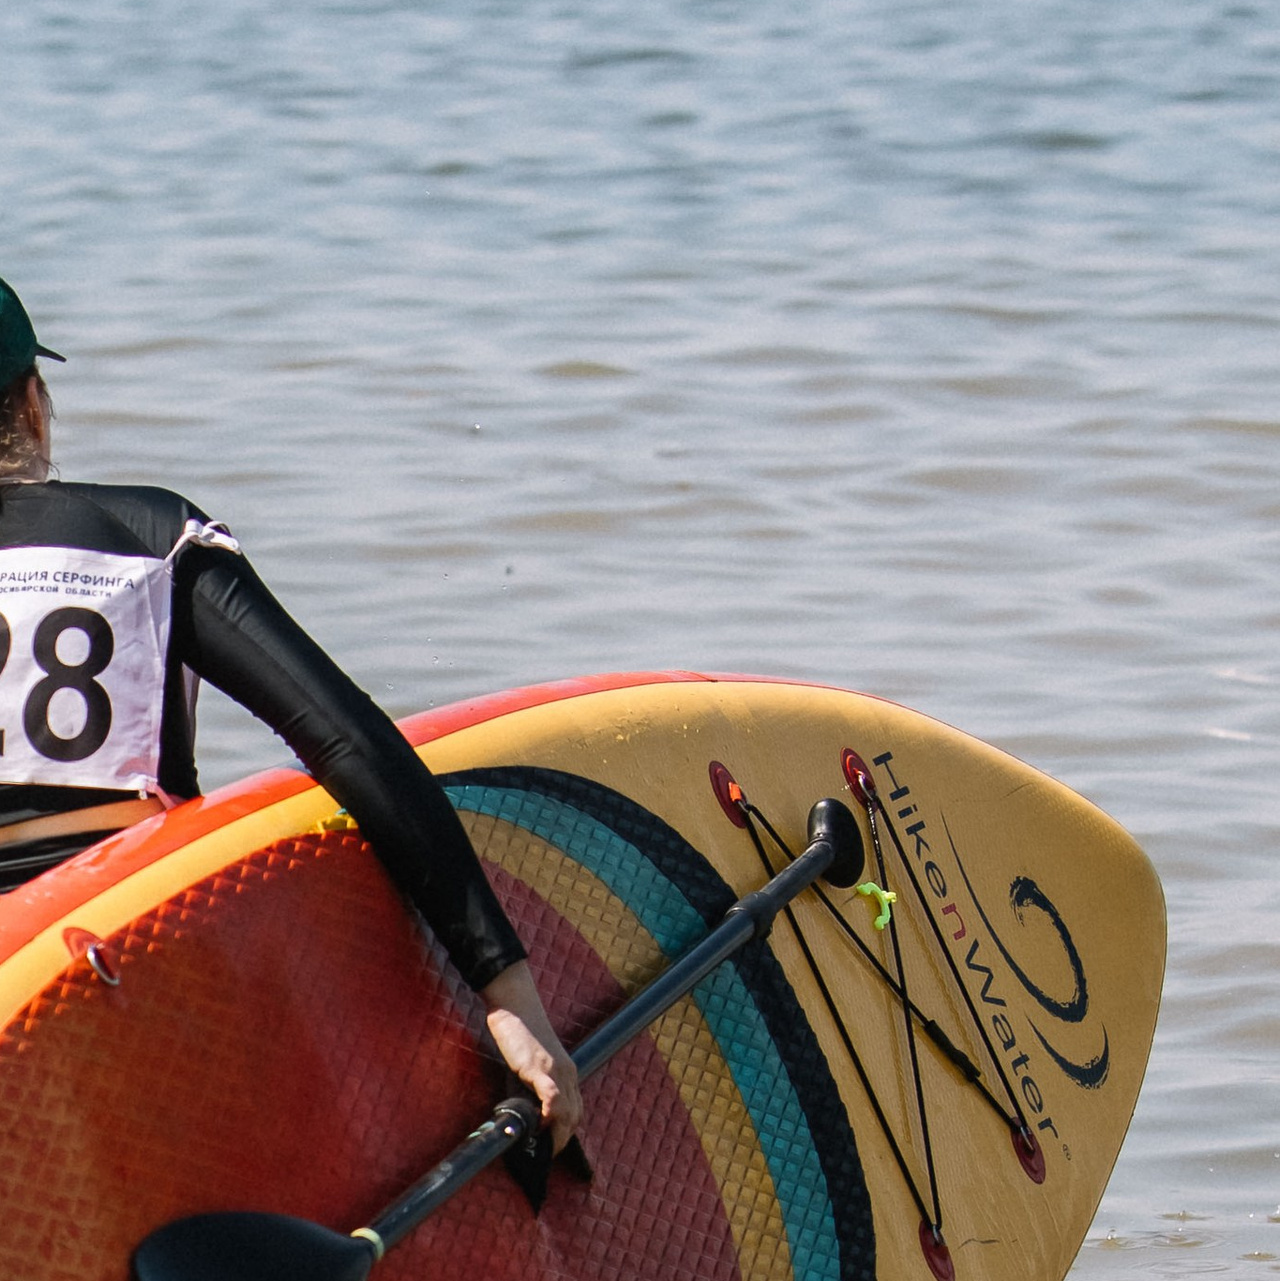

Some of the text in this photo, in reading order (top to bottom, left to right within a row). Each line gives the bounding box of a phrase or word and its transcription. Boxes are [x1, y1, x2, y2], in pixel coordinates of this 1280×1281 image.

[52, 570, 136, 590] СЕРФИНГА
[64, 586, 113, 599] ОБЛАСТИ
[872, 750, 1060, 1139] HikenWater
